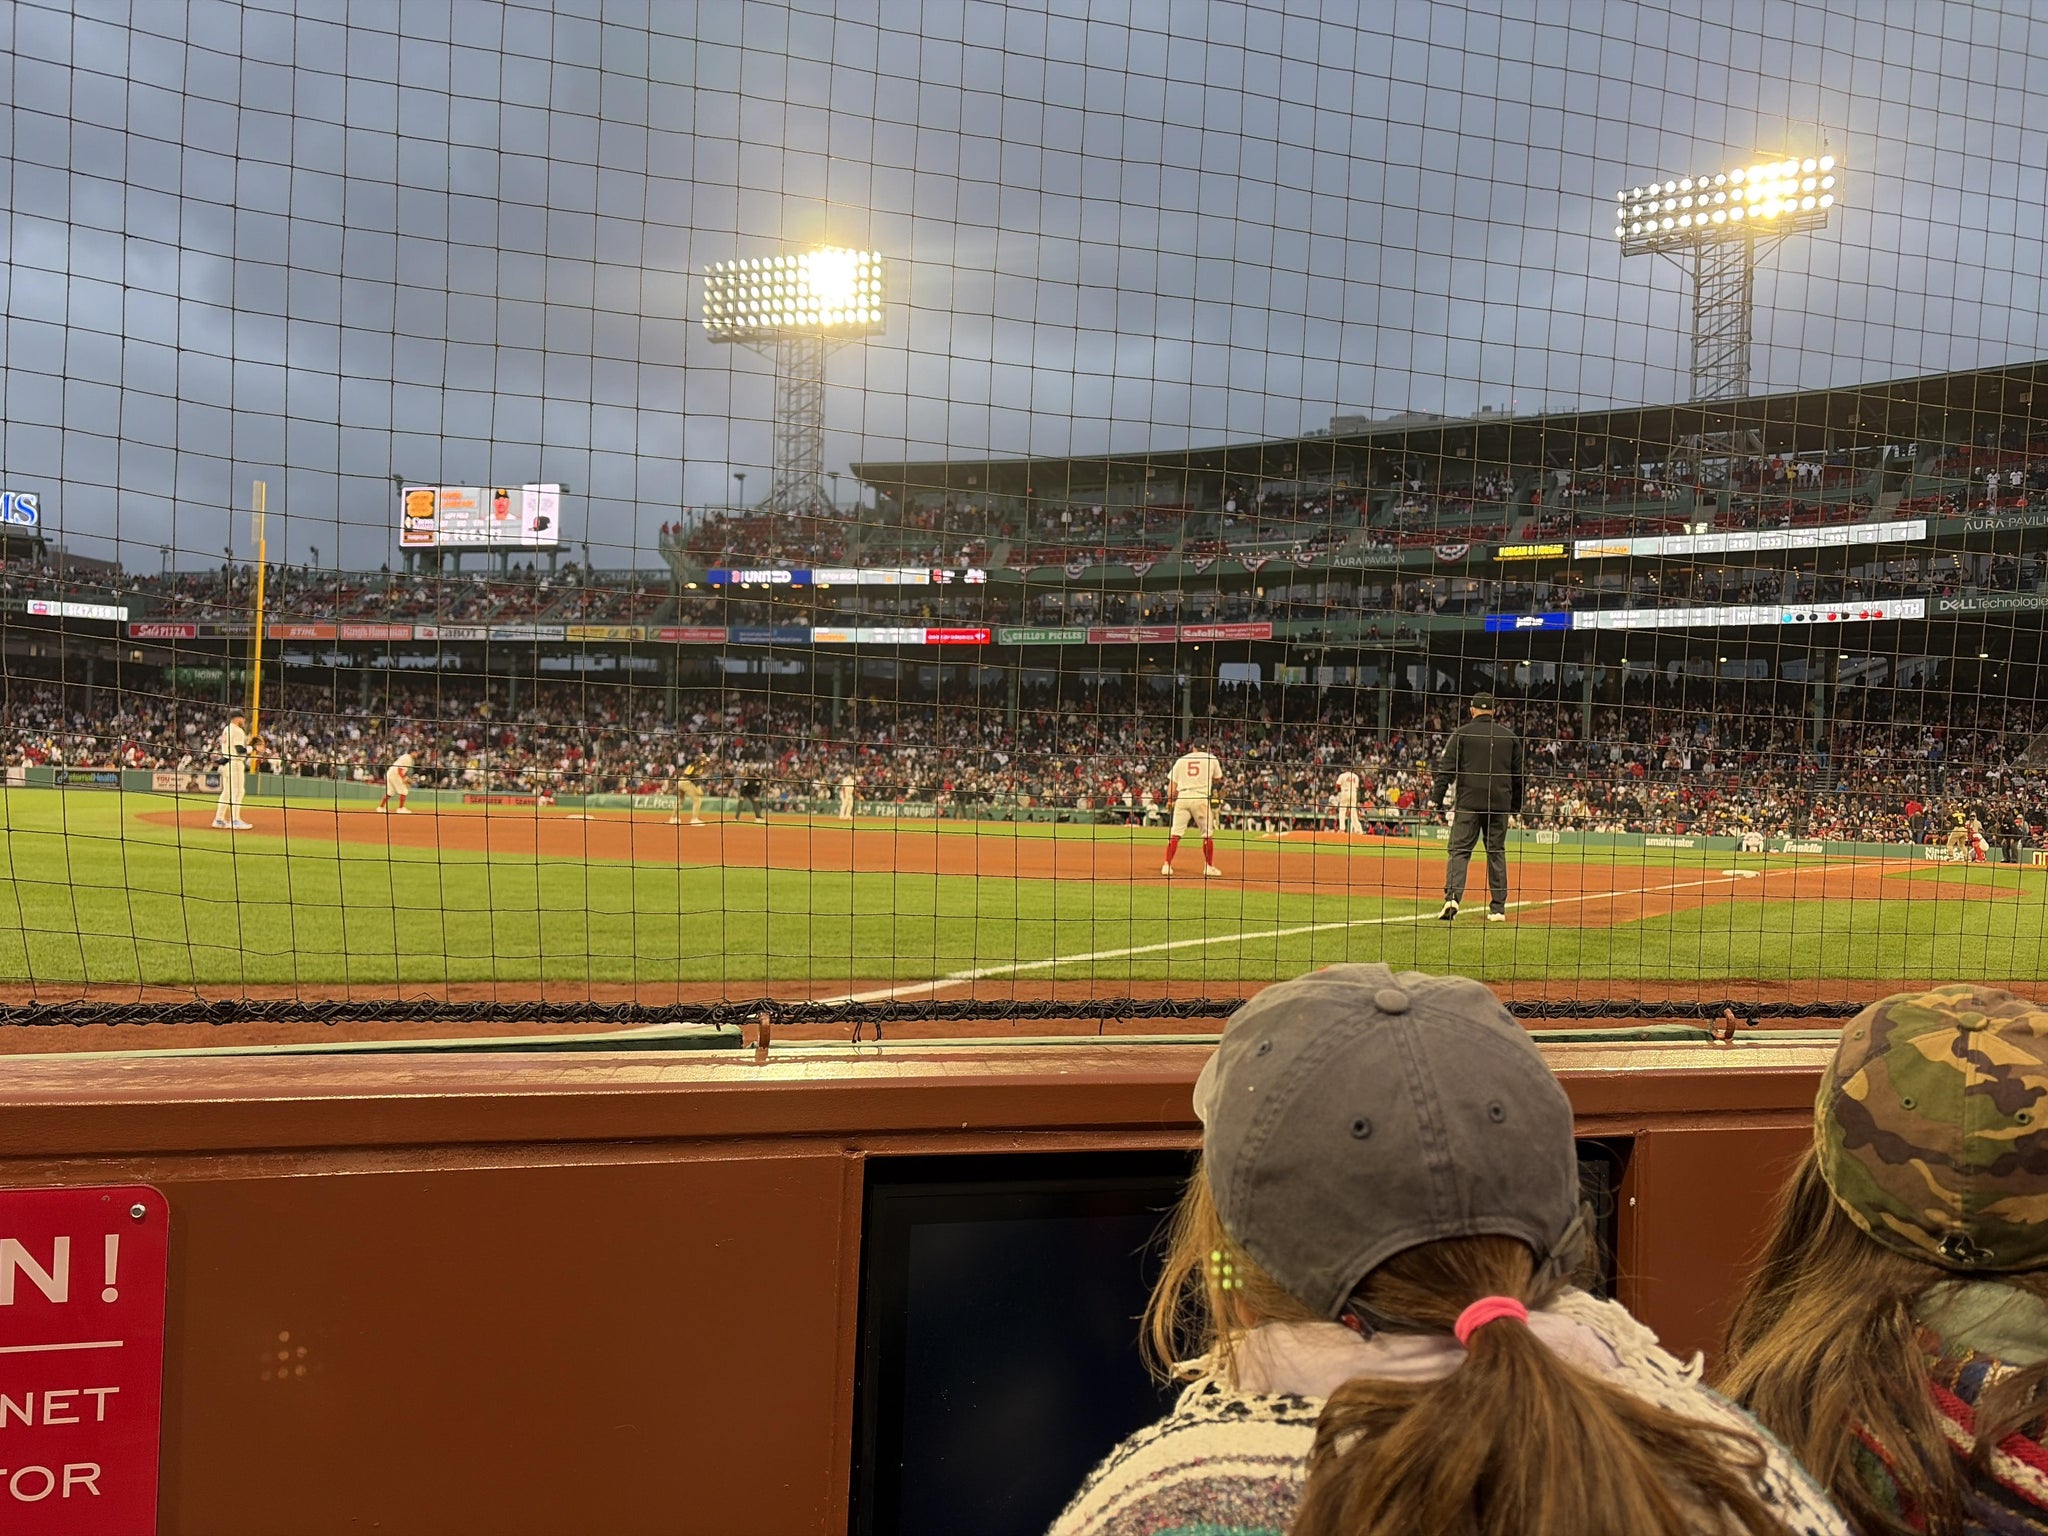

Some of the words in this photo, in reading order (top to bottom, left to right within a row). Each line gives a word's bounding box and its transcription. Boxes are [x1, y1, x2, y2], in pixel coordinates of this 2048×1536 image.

[2008, 514, 2048, 528] PAVILI
[1364, 554, 1406, 564] PAVILION
[1862, 602, 1880, 610] OUT
[1895, 603, 1920, 615] 9TH
[1737, 610, 1757, 621] MVR
[160, 625, 187, 637] PIZZA
[289, 627, 318, 636] STIHL
[1183, 628, 1226, 638] Safelite
[1187, 761, 1201, 777] 5
[633, 796, 679, 809] L.L.Bea
[1782, 841, 1824, 853] Franklin
